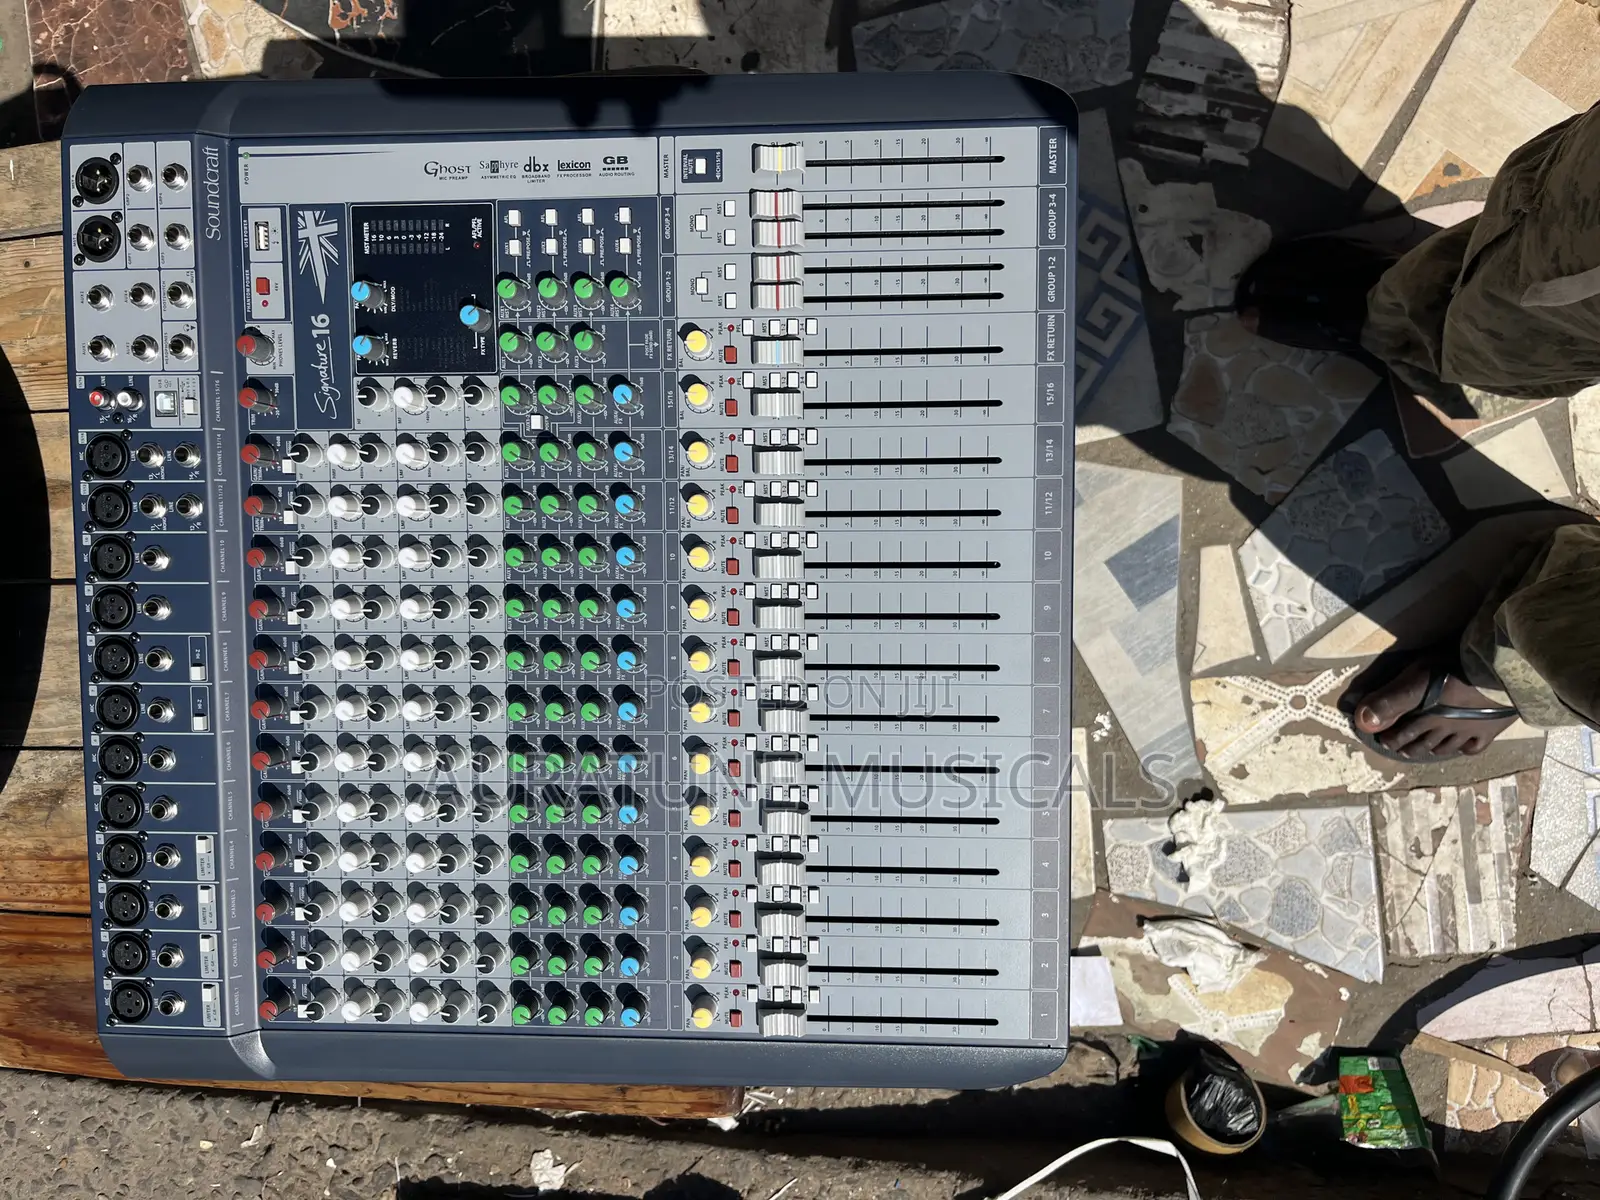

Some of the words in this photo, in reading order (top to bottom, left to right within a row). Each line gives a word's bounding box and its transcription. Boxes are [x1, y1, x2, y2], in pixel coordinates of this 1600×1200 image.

[523, 156, 549, 173] dbx
[602, 156, 629, 165] GB
[1049, 137, 1058, 174] MASTER
[423, 160, 472, 178] Ghost
[479, 160, 519, 174] Sapphyre
[202, 145, 222, 241] Soundcraft
[1049, 193, 1057, 207] 3-4
[1048, 209, 1058, 240] GROUP
[1048, 256, 1057, 270] 1-2
[1047, 272, 1057, 303] GROUP
[311, 313, 330, 339] 16
[1047, 314, 1056, 349] RETURN
[666, 353, 672, 361] FX
[1047, 350, 1056, 362] FX
[311, 339, 341, 420] Signature
[1046, 382, 1055, 406] 15/16
[1045, 439, 1054, 463] 13/14
[1044, 491, 1054, 515] 11/12
[669, 553, 676, 561] 10
[1044, 551, 1053, 561] 10
